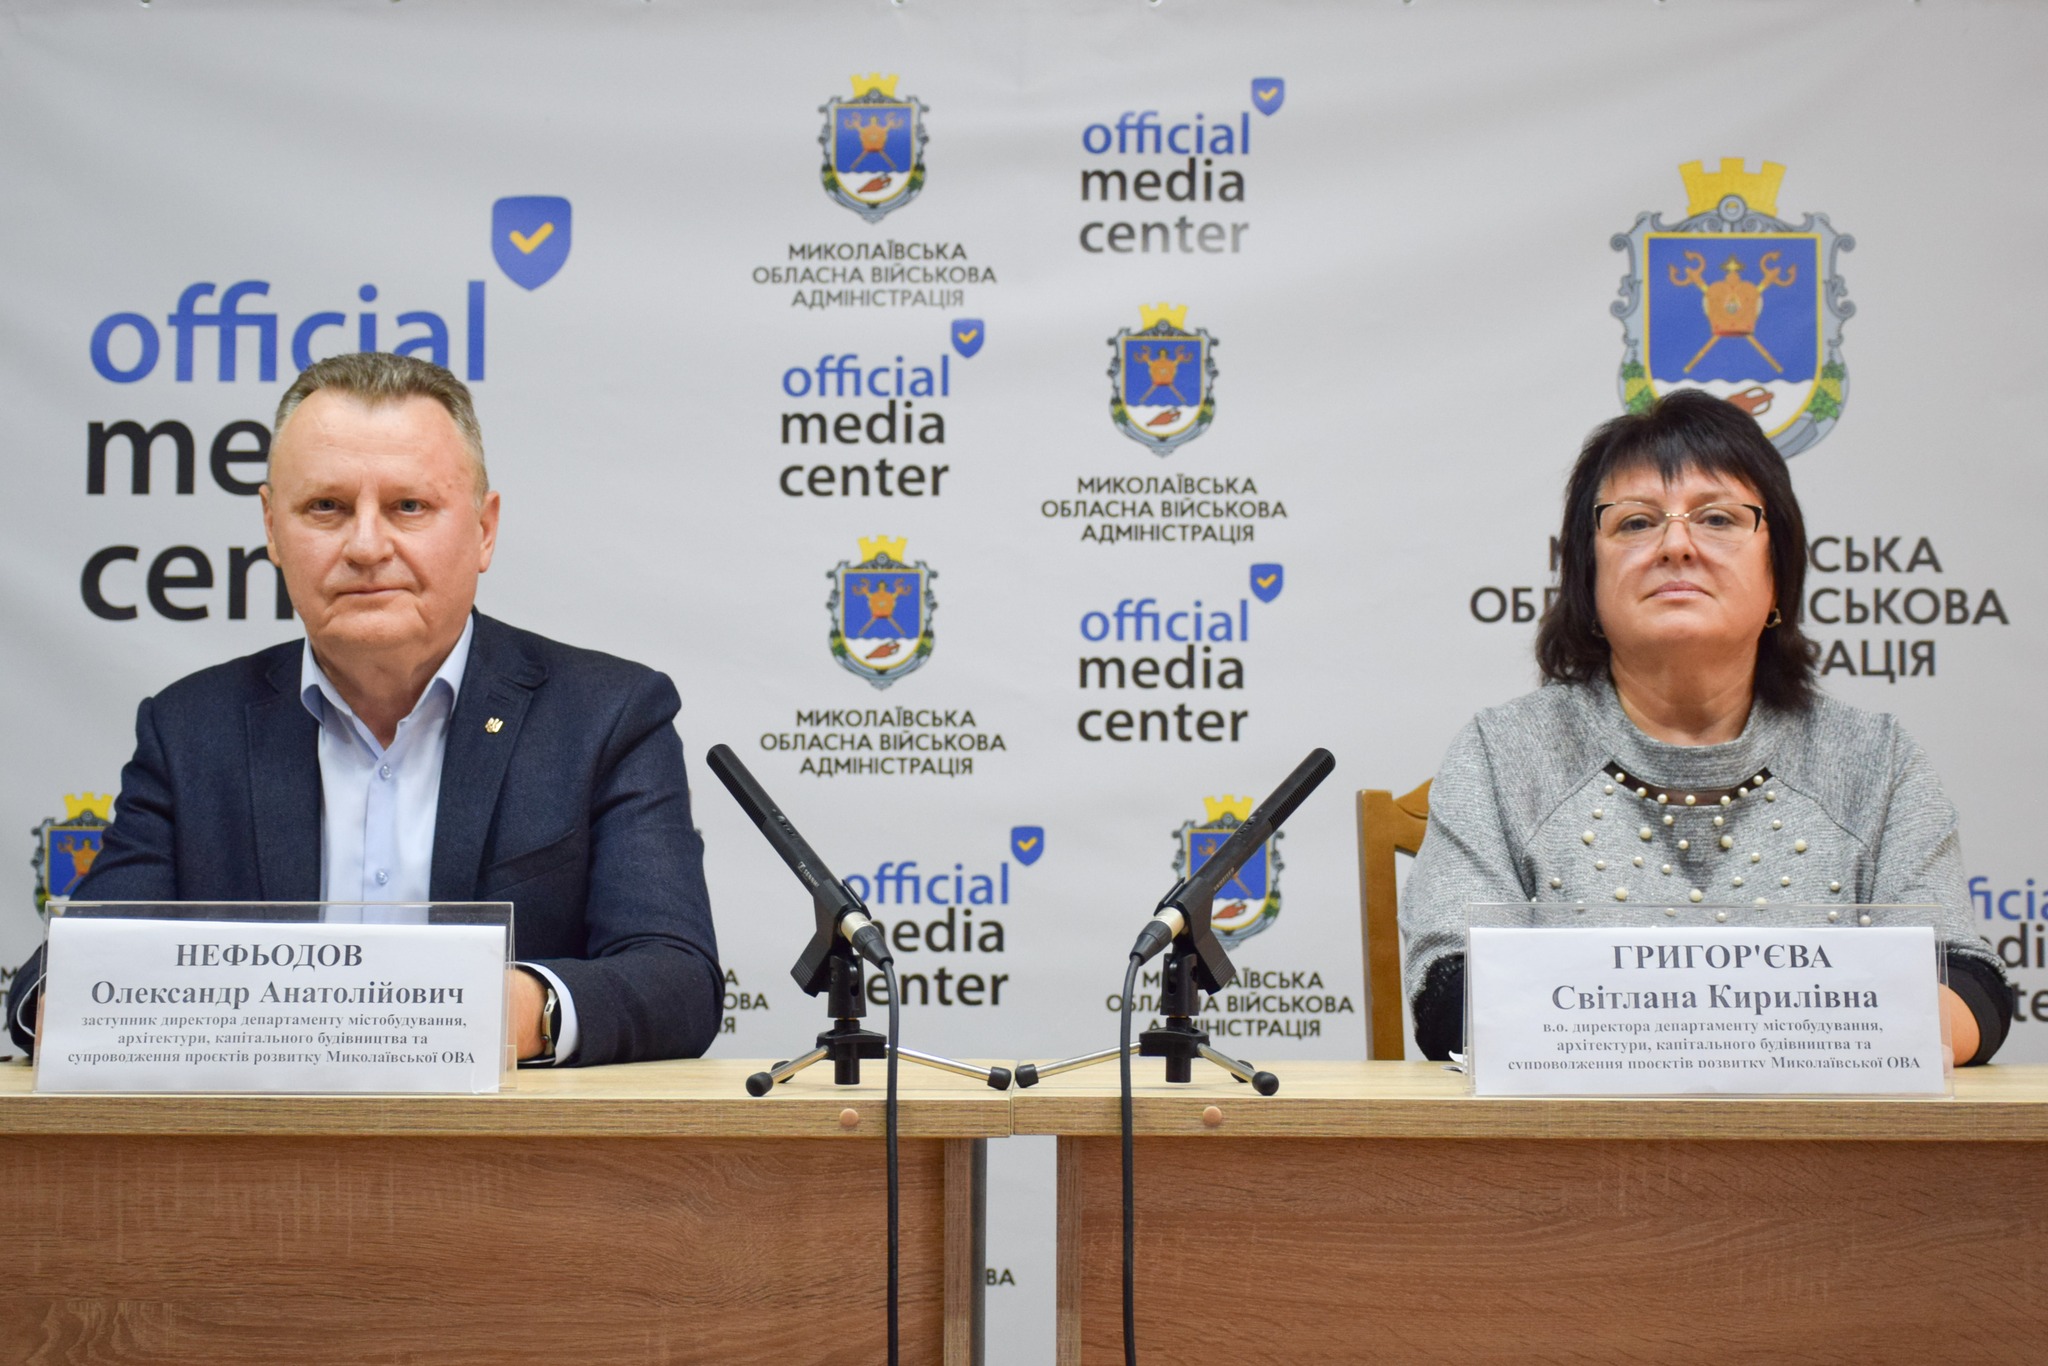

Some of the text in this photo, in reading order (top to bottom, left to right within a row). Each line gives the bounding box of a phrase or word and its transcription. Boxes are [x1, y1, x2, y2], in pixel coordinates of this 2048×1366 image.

[1081, 111, 1250, 156] official
[1081, 156, 1245, 203] media
[1078, 215, 1249, 254] center
[788, 239, 968, 261] МИКОЛАЇВСЬКА
[751, 262, 997, 285] ОБЛАСНА ВІЙСЬКОВА
[790, 288, 964, 311] АДМІНІСТРАЦІЯ
[782, 353, 950, 398] official
[781, 398, 945, 445] media
[779, 458, 950, 498] center
[1077, 473, 1258, 495] МИКОЛАЇВСЬКА
[1040, 497, 1288, 519] ОБЛАСНА ВІЙСЬКОВА
[1080, 523, 1255, 545] АДМІНІСТРАЦІЯ
[1798, 588, 2010, 625] СЬКОВА
[1079, 597, 1249, 643] official
[1079, 643, 1244, 690] media
[796, 705, 977, 728] МИКОЛАЇВСЬКА
[1077, 703, 1249, 743] center
[759, 729, 1007, 752] ОБЛАСНА ВІЙСЬКОВА
[799, 756, 974, 778] АДМІНІСТРАЦІЯ
[846, 862, 1009, 904] official
[175, 943, 363, 971] НЕФЬОДОВ
[1613, 944, 1833, 969] ГРИГОР'ЄВА
[866, 966, 1009, 1006] enter
[1143, 967, 1324, 989] МАЇВСЬКА
[91, 980, 464, 1010] Олександр Анатолійович
[1226, 991, 1355, 1014] ВІЙСЬКОВА
[1551, 983, 1879, 1016] Світлана Кирилівна
[81, 1013, 467, 1029] заступник директора департаменту містобудування,
[1149, 1019, 1321, 1039] АІНІСТРАЦІЯ
[1543, 1018, 1883, 1036] в.о. директора департаменту містобудування,
[117, 1031, 428, 1047] архітектури, капітального будівництва та
[1556, 1037, 1872, 1055] архітектури, капітального будівництва та
[67, 1049, 475, 1066] супроводження проєктів розвитку Миколаївської ОВА
[1771, 1056, 1883, 1069] Миколаївської
[1886, 1056, 1921, 1069] ОВА
